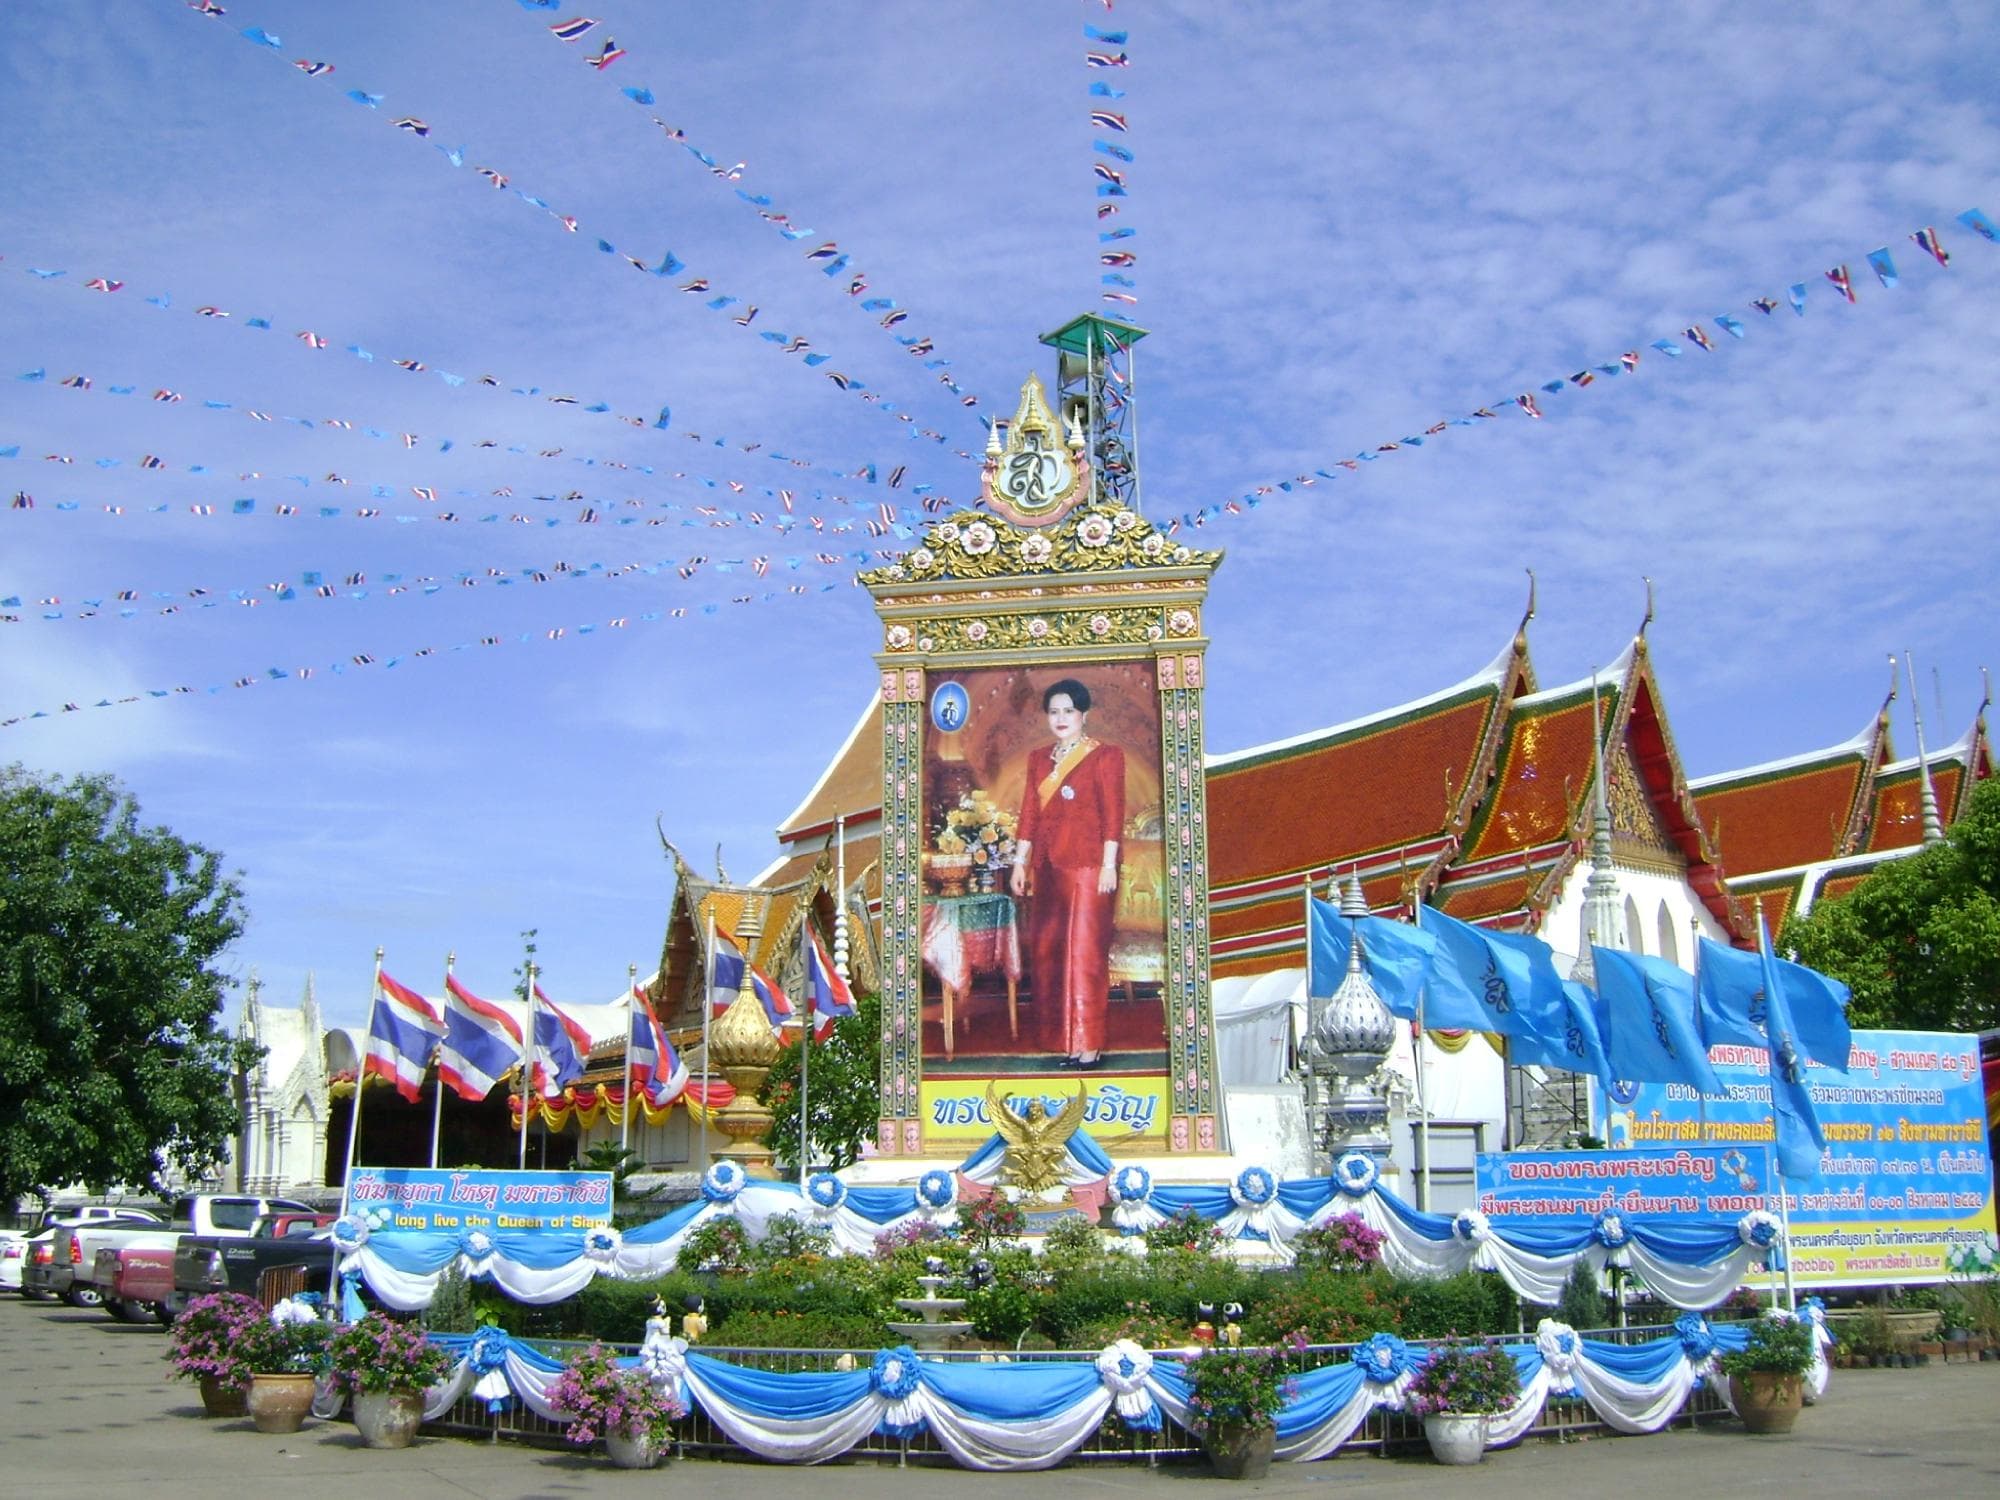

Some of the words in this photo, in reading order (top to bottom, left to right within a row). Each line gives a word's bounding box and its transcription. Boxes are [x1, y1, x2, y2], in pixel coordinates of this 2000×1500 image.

[1508, 1151, 1715, 1182] ขอจงทรงพระเจริญ
[449, 1173, 500, 1210] โหตุ
[504, 1179, 610, 1204] มหาราชินี
[395, 1213, 427, 1230] long
[434, 1213, 459, 1228] live
[465, 1214, 491, 1228] the
[497, 1214, 544, 1229] Queen
[550, 1214, 566, 1229] of
